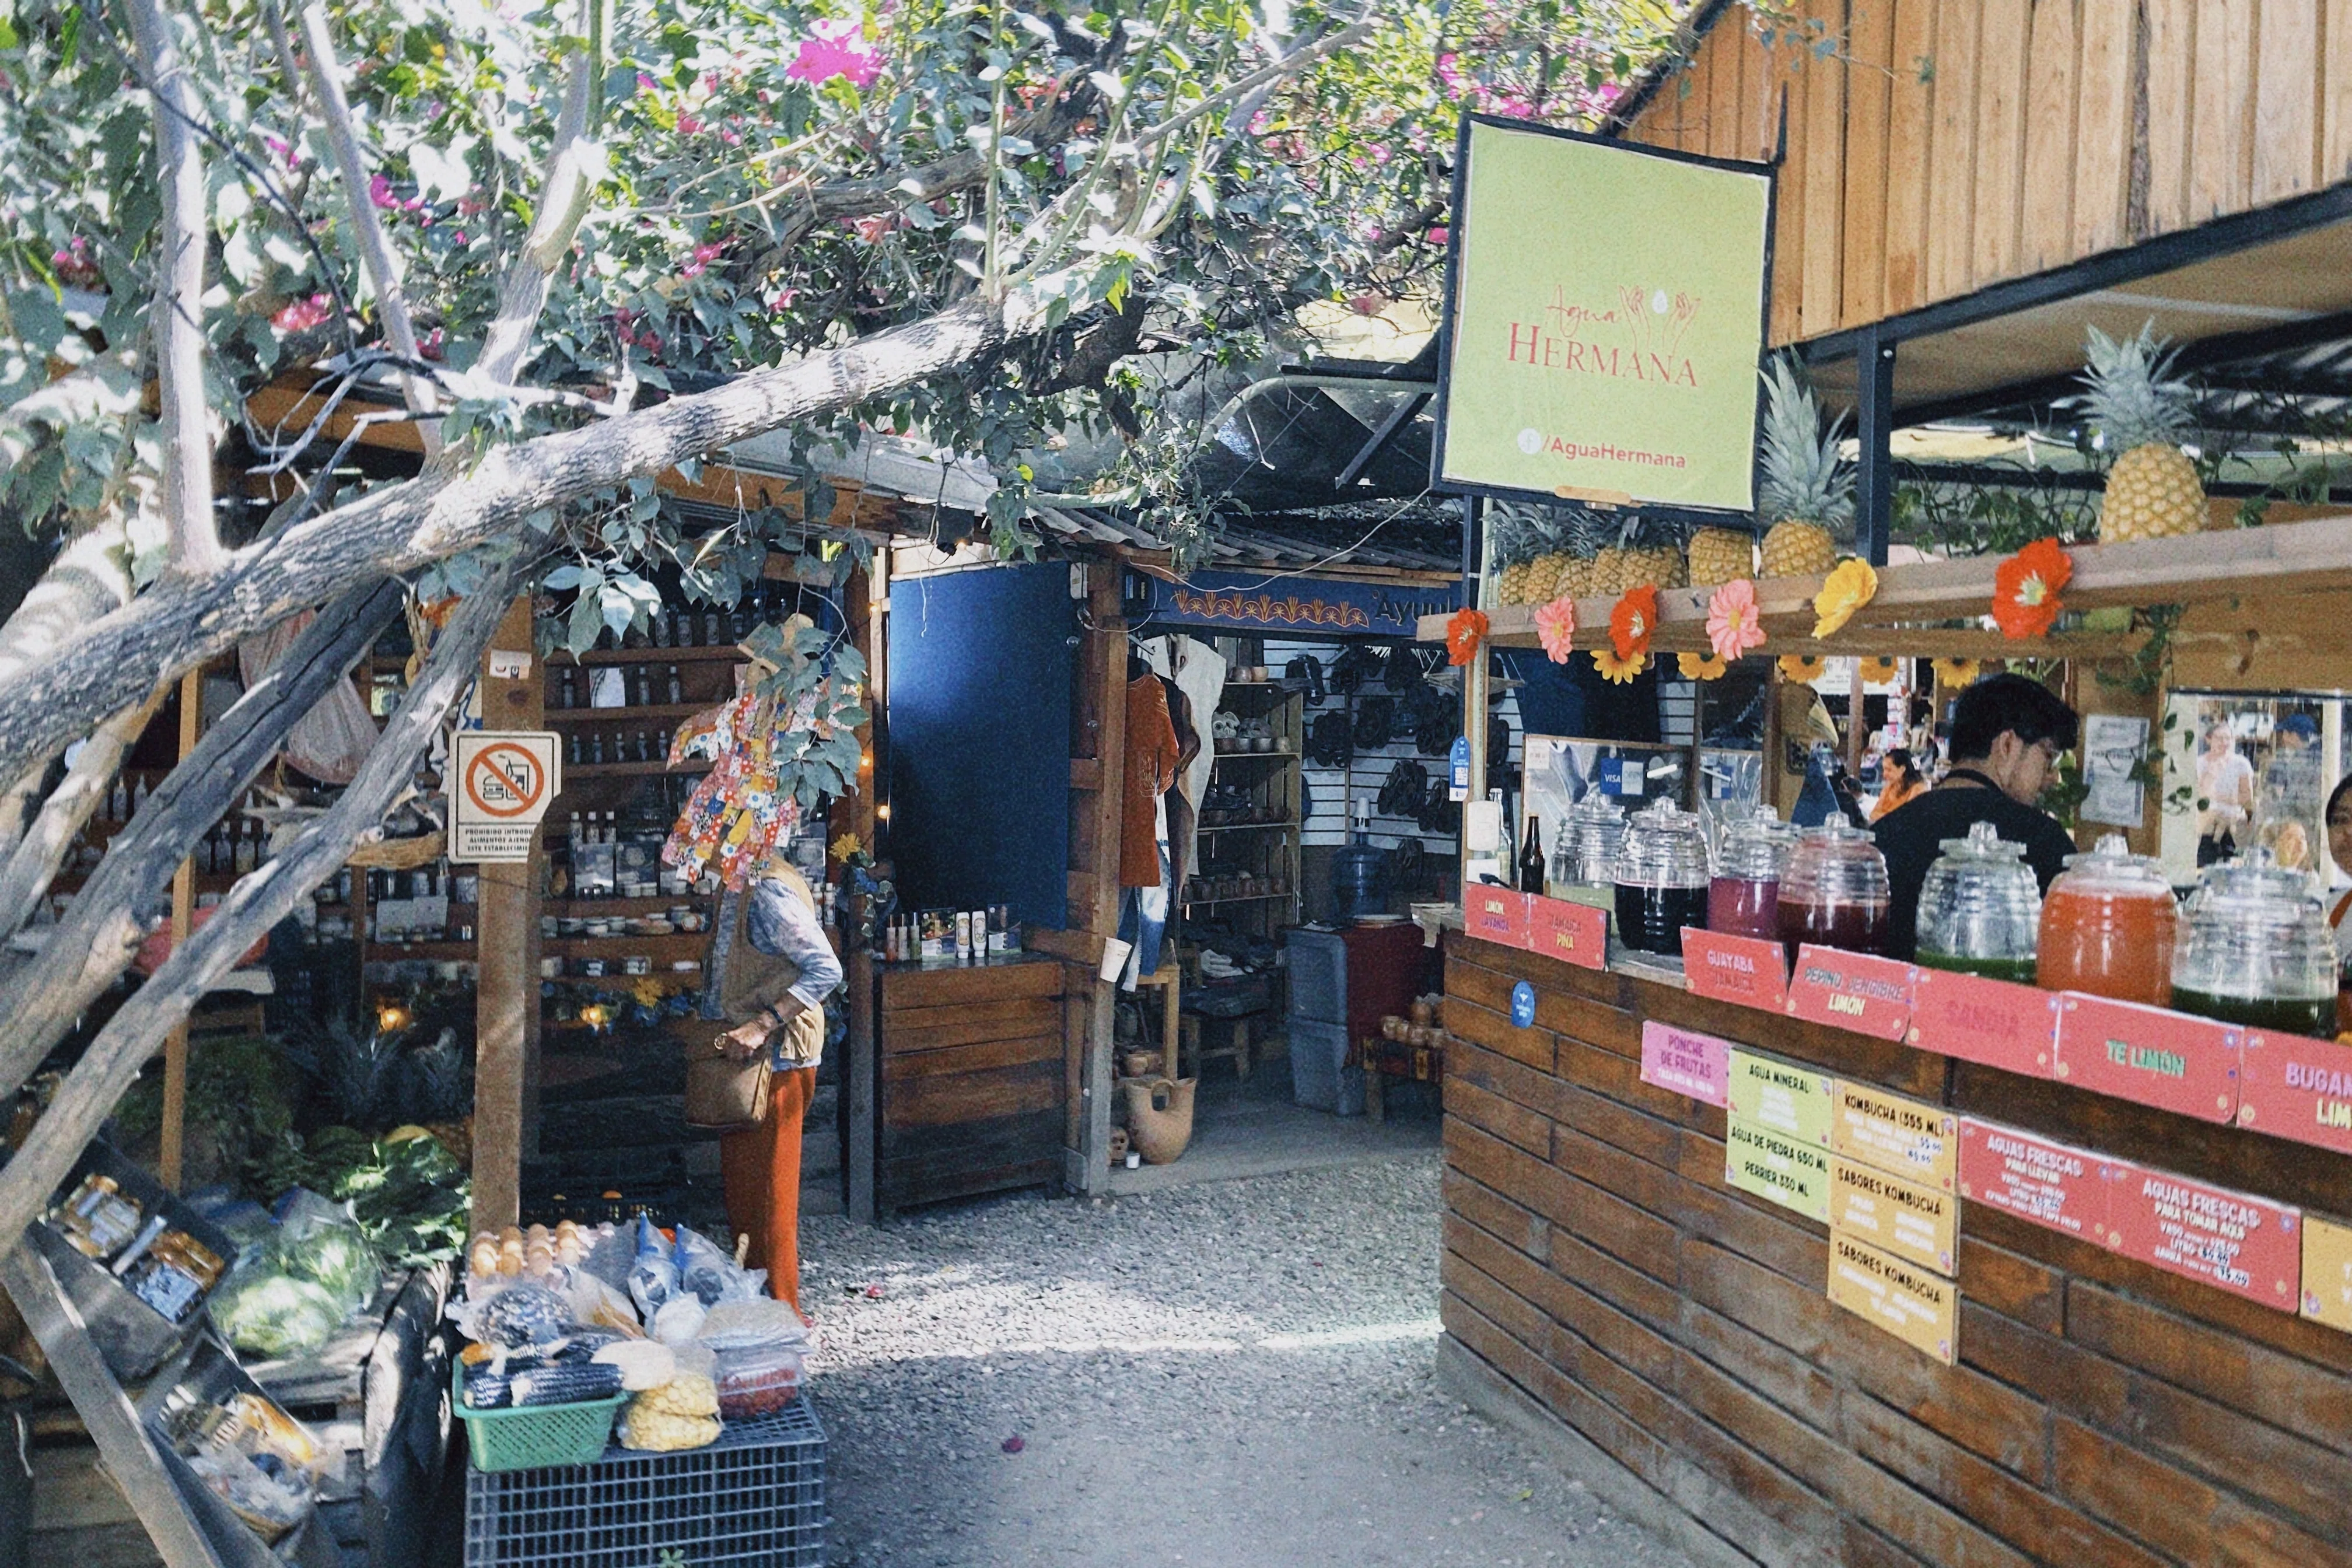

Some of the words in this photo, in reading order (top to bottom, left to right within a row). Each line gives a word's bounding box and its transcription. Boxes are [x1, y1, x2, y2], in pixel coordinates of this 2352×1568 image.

[1545, 284, 1618, 337] Agua
[1507, 321, 1698, 387] HERMANA
[1542, 435, 1686, 468] /AguaHermana
[1604, 774, 1621, 783] VISA
[1707, 949, 1755, 974] GUAYABA
[1804, 967, 1842, 987] PEPINO
[1846, 975, 1908, 1000] JENGIBRE
[1828, 992, 1866, 1017] LIMÓN
[1668, 1034, 1704, 1058] PONCHE
[1661, 1050, 1672, 1066] DE
[1675, 1055, 1711, 1079] FRUTAS
[1749, 1063, 1770, 1081] AGUA
[2131, 1048, 2186, 1079] LIMÓN
[1845, 1093, 1896, 1122] KOMBUCHA
[1731, 1125, 1751, 1144] AGUA
[1754, 1134, 1764, 1149] DE
[1766, 1138, 1794, 1161] PIEDRA
[1797, 1149, 1814, 1167] 650
[1816, 1154, 1828, 1173] ML
[1987, 1133, 2025, 1161] AGUAS
[1745, 1161, 1777, 1185] PERRIER
[1779, 1174, 1796, 1191] 330
[1797, 1181, 1809, 1197] ML
[1838, 1167, 1882, 1195] SABORES
[2143, 1177, 2189, 1209] AGUAS
[2155, 1200, 2181, 1222] PARA
[2183, 1209, 2218, 1234] TOMAR
[1838, 1241, 1882, 1275] SABORES
[1884, 1264, 1941, 1305] KOMBUCHA
